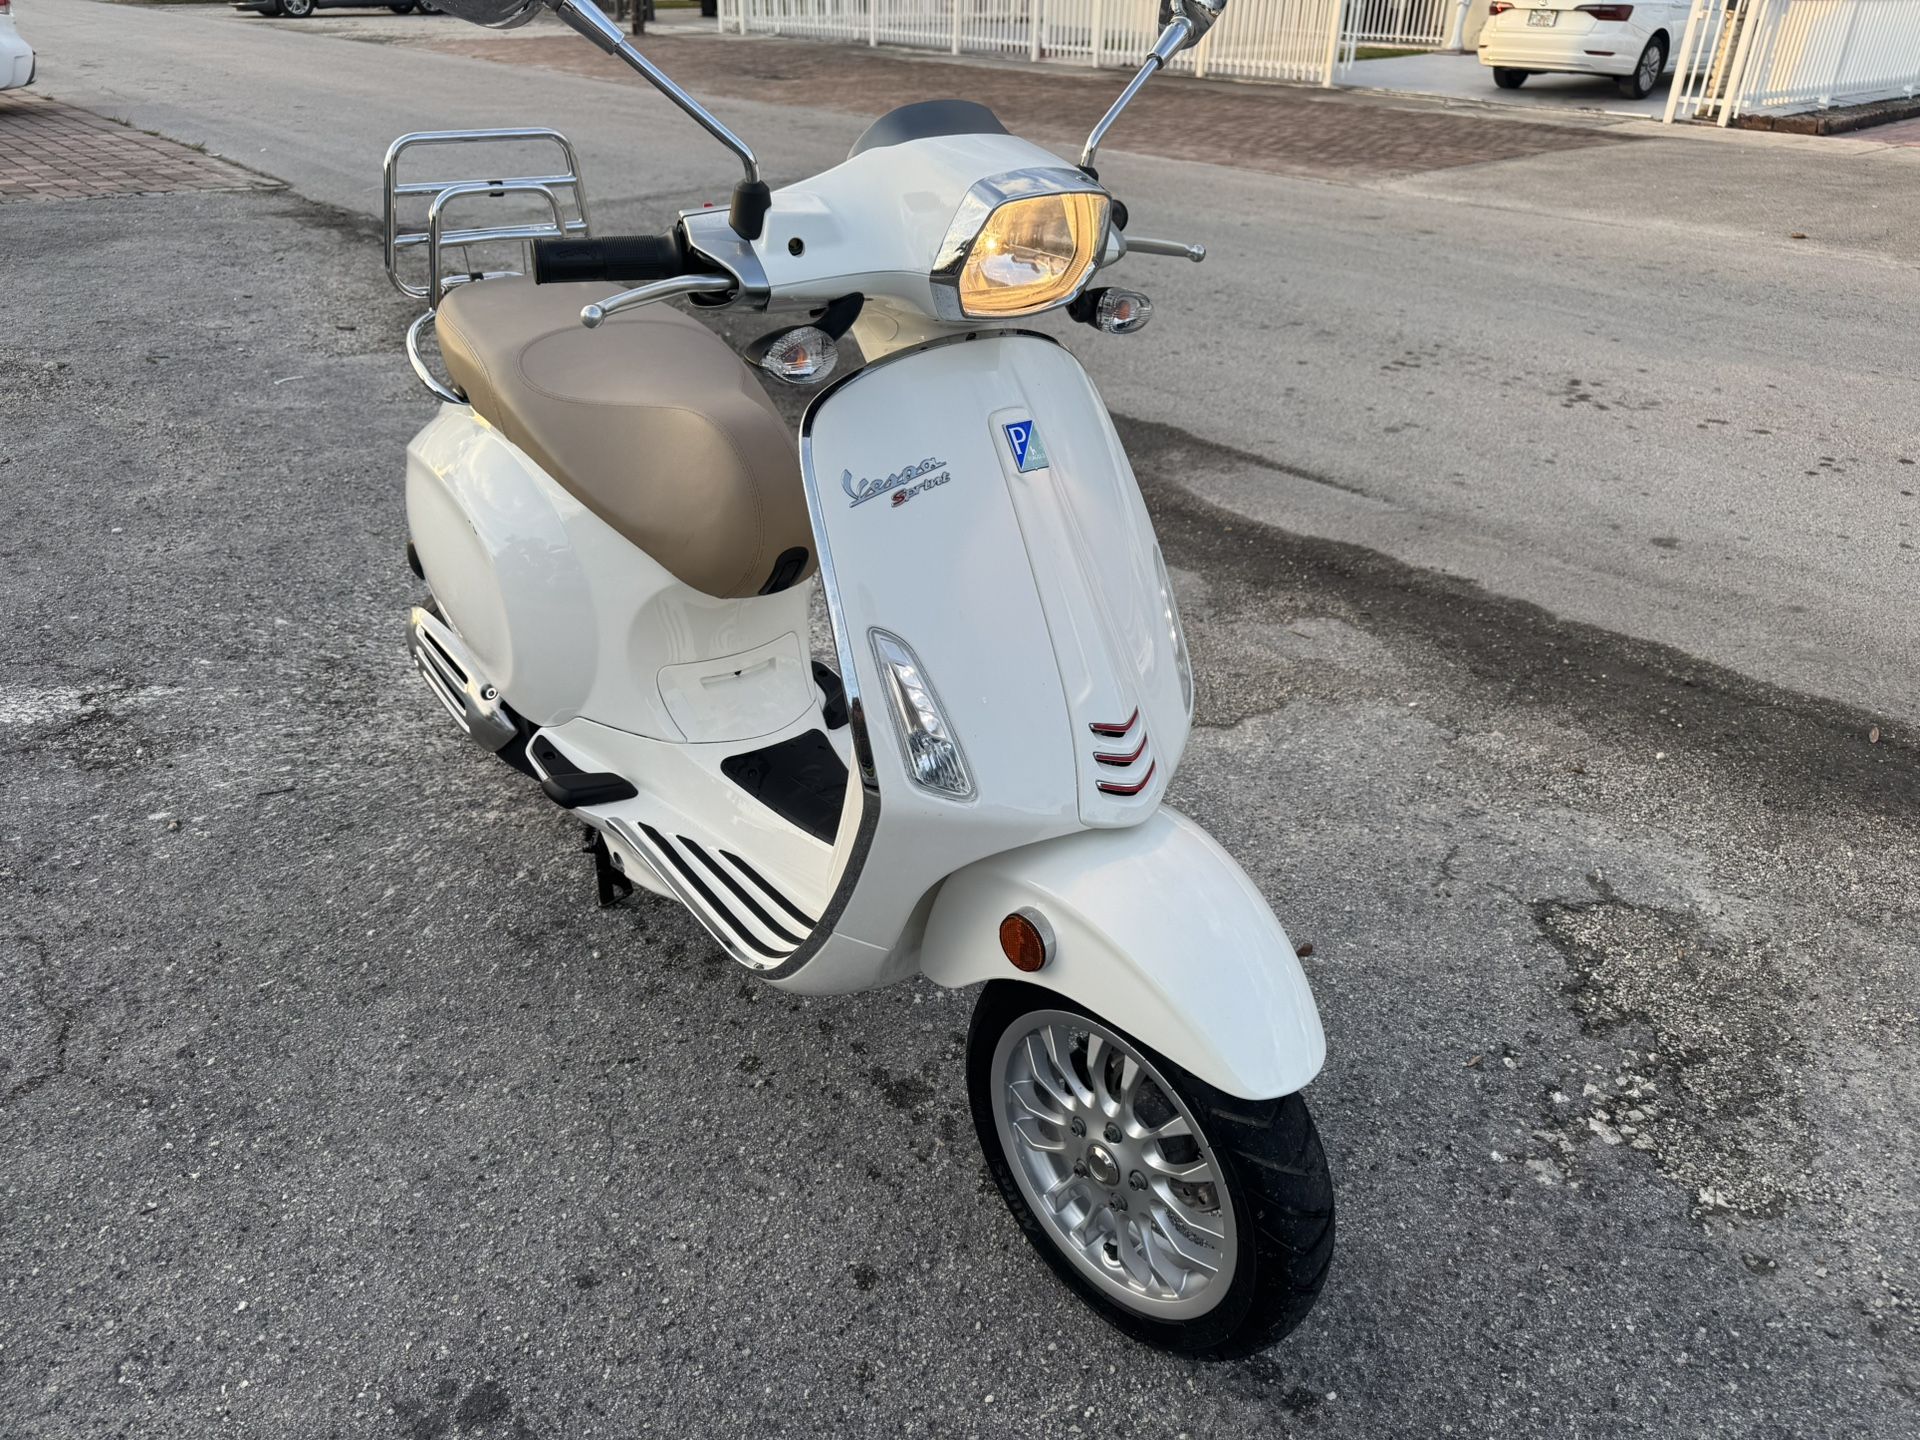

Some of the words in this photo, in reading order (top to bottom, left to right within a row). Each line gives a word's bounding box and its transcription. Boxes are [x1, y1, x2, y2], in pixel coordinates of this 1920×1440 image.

[1008, 427, 1026, 455] P
[841, 457, 946, 508] Vespa
[891, 471, 951, 508] Sprint
